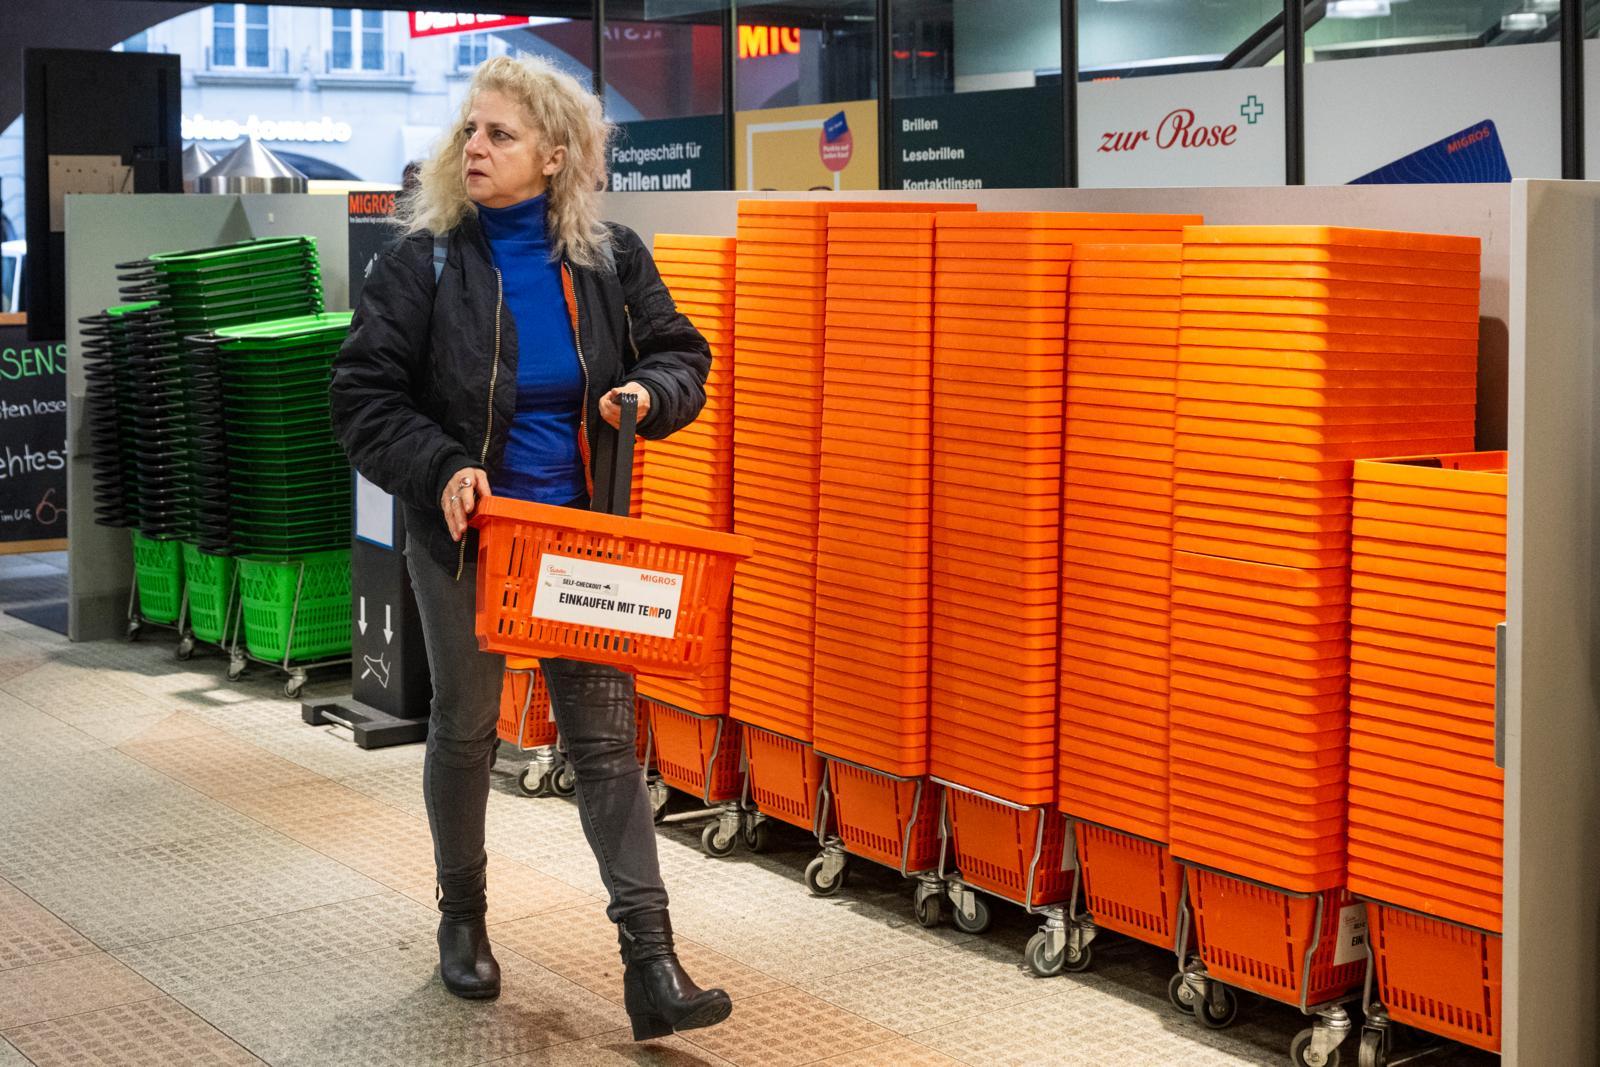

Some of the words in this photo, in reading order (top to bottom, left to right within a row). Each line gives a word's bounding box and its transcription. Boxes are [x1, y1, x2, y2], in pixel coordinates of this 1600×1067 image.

[902, 118, 938, 132] Brillen
[1097, 129, 1150, 152] zur
[1156, 108, 1238, 150] Rose
[1447, 127, 1490, 154] MIGROS
[611, 143, 684, 166] Fachgeschäft
[685, 141, 702, 159] für
[902, 146, 965, 162] Lesebrillen
[612, 171, 660, 192] Brillen
[661, 168, 692, 190] und
[903, 177, 983, 190] Kontaktlinsen
[349, 193, 396, 216] MIGROS
[0, 400, 32, 420] ten
[562, 578, 602, 590] SELF-CHECKOUT
[640, 574, 677, 586] MIGROS
[559, 592, 615, 611] EINKAUFEN
[617, 601, 636, 614] MIT
[638, 604, 672, 620] TEMPO
